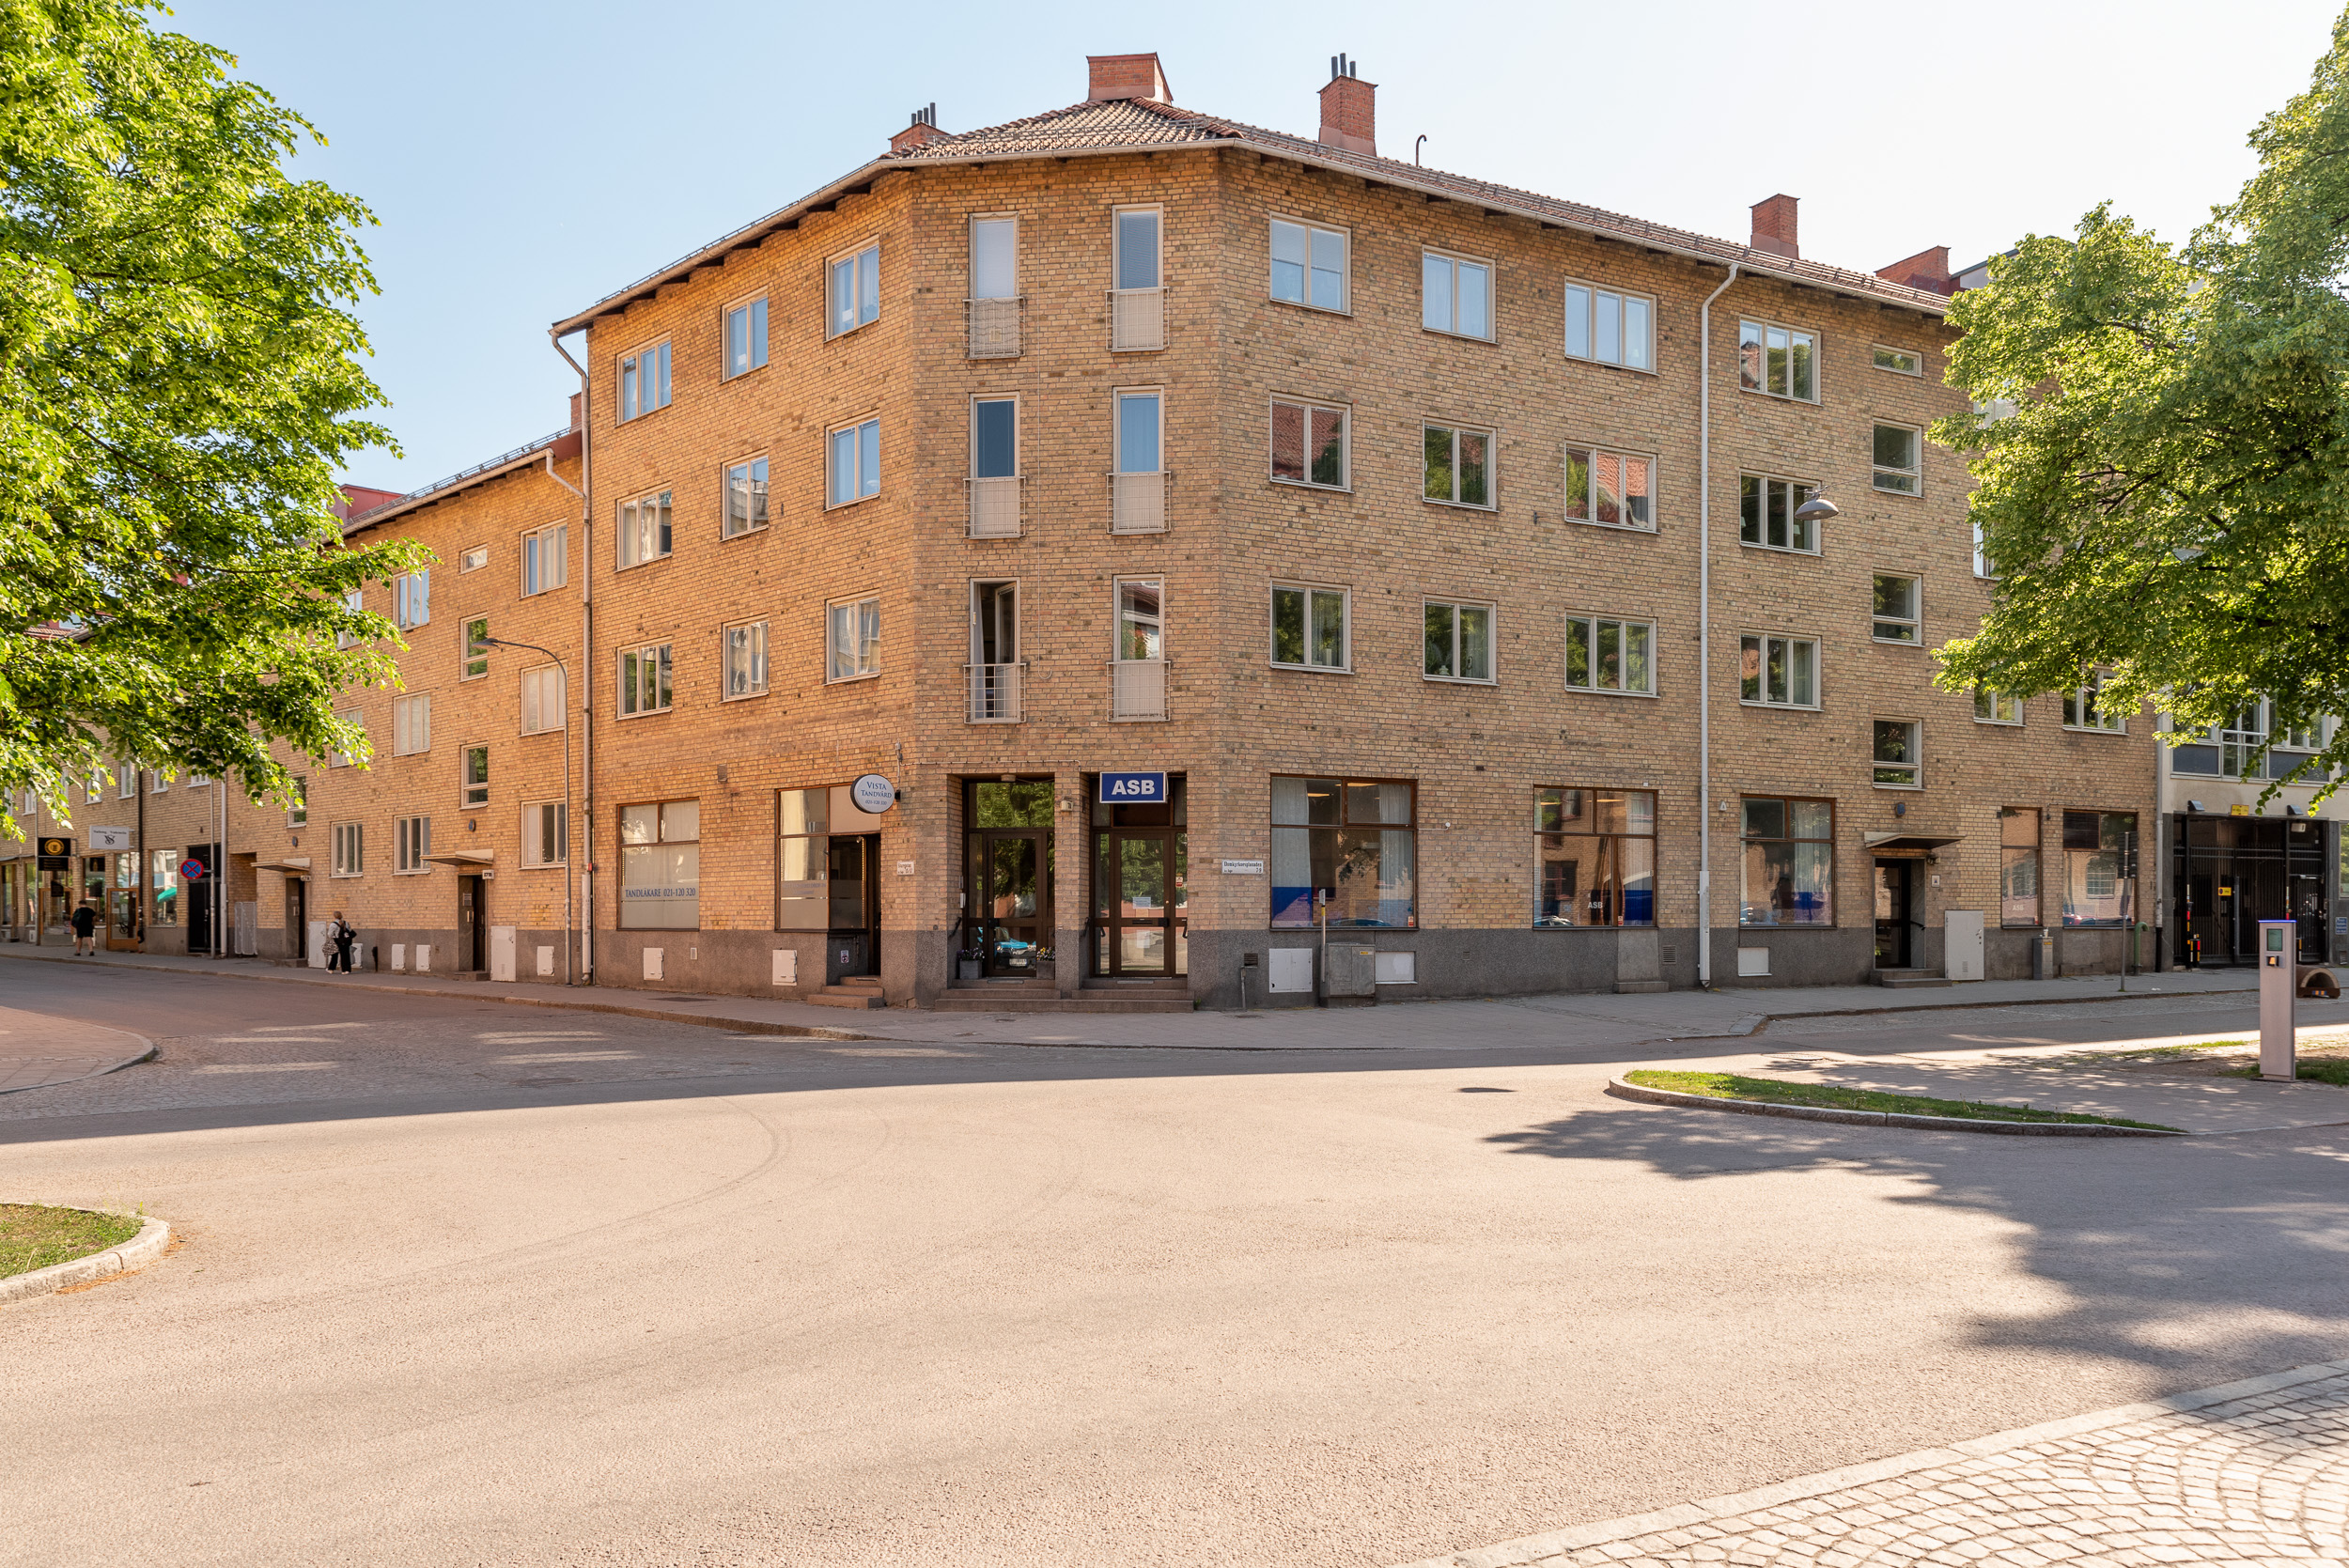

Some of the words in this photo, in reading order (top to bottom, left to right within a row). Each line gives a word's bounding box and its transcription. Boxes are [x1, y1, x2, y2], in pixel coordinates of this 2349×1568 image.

[1112, 780, 1155, 795] ASB
[625, 888, 661, 897] TANDLÄKARE
[663, 888, 685, 897] 021-120
[686, 888, 696, 896] 320
